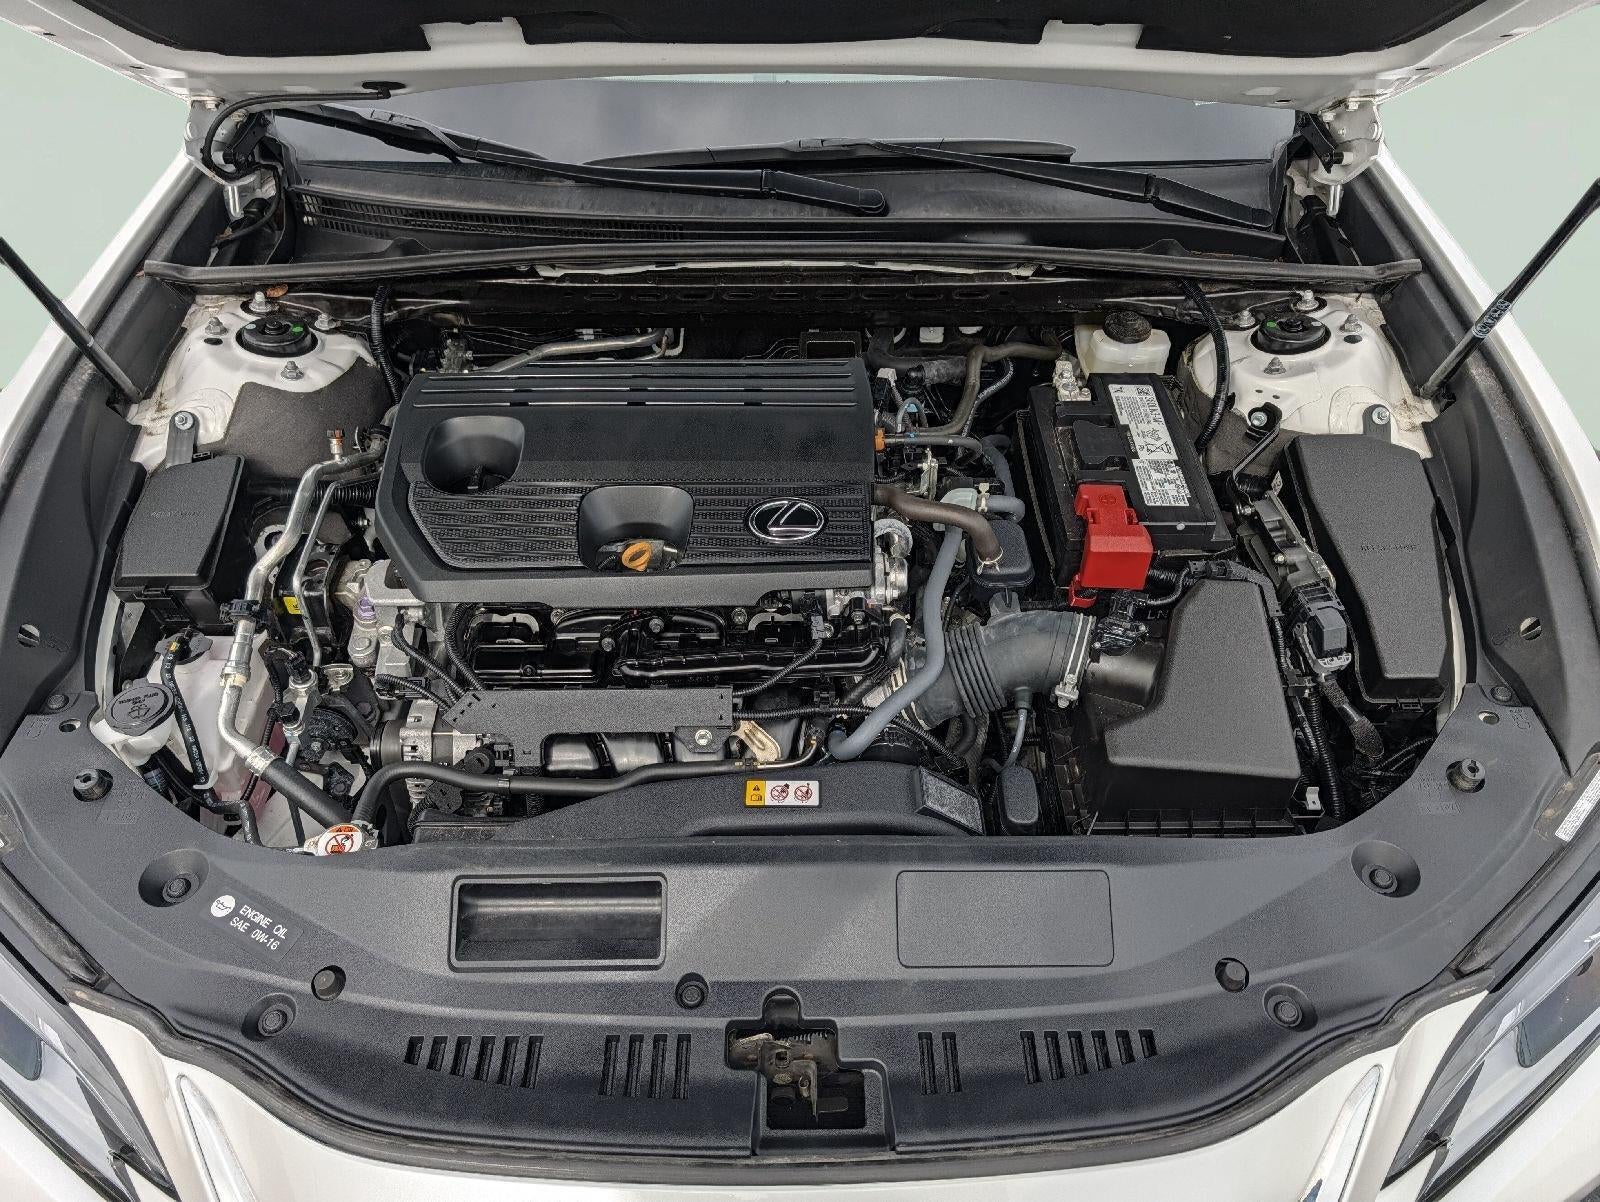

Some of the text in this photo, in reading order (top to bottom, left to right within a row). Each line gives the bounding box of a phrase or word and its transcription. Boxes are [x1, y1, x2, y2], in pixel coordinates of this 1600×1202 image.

[230, 917, 280, 950] SAE 0W-16
[240, 905, 287, 939] ENGINE OIL
